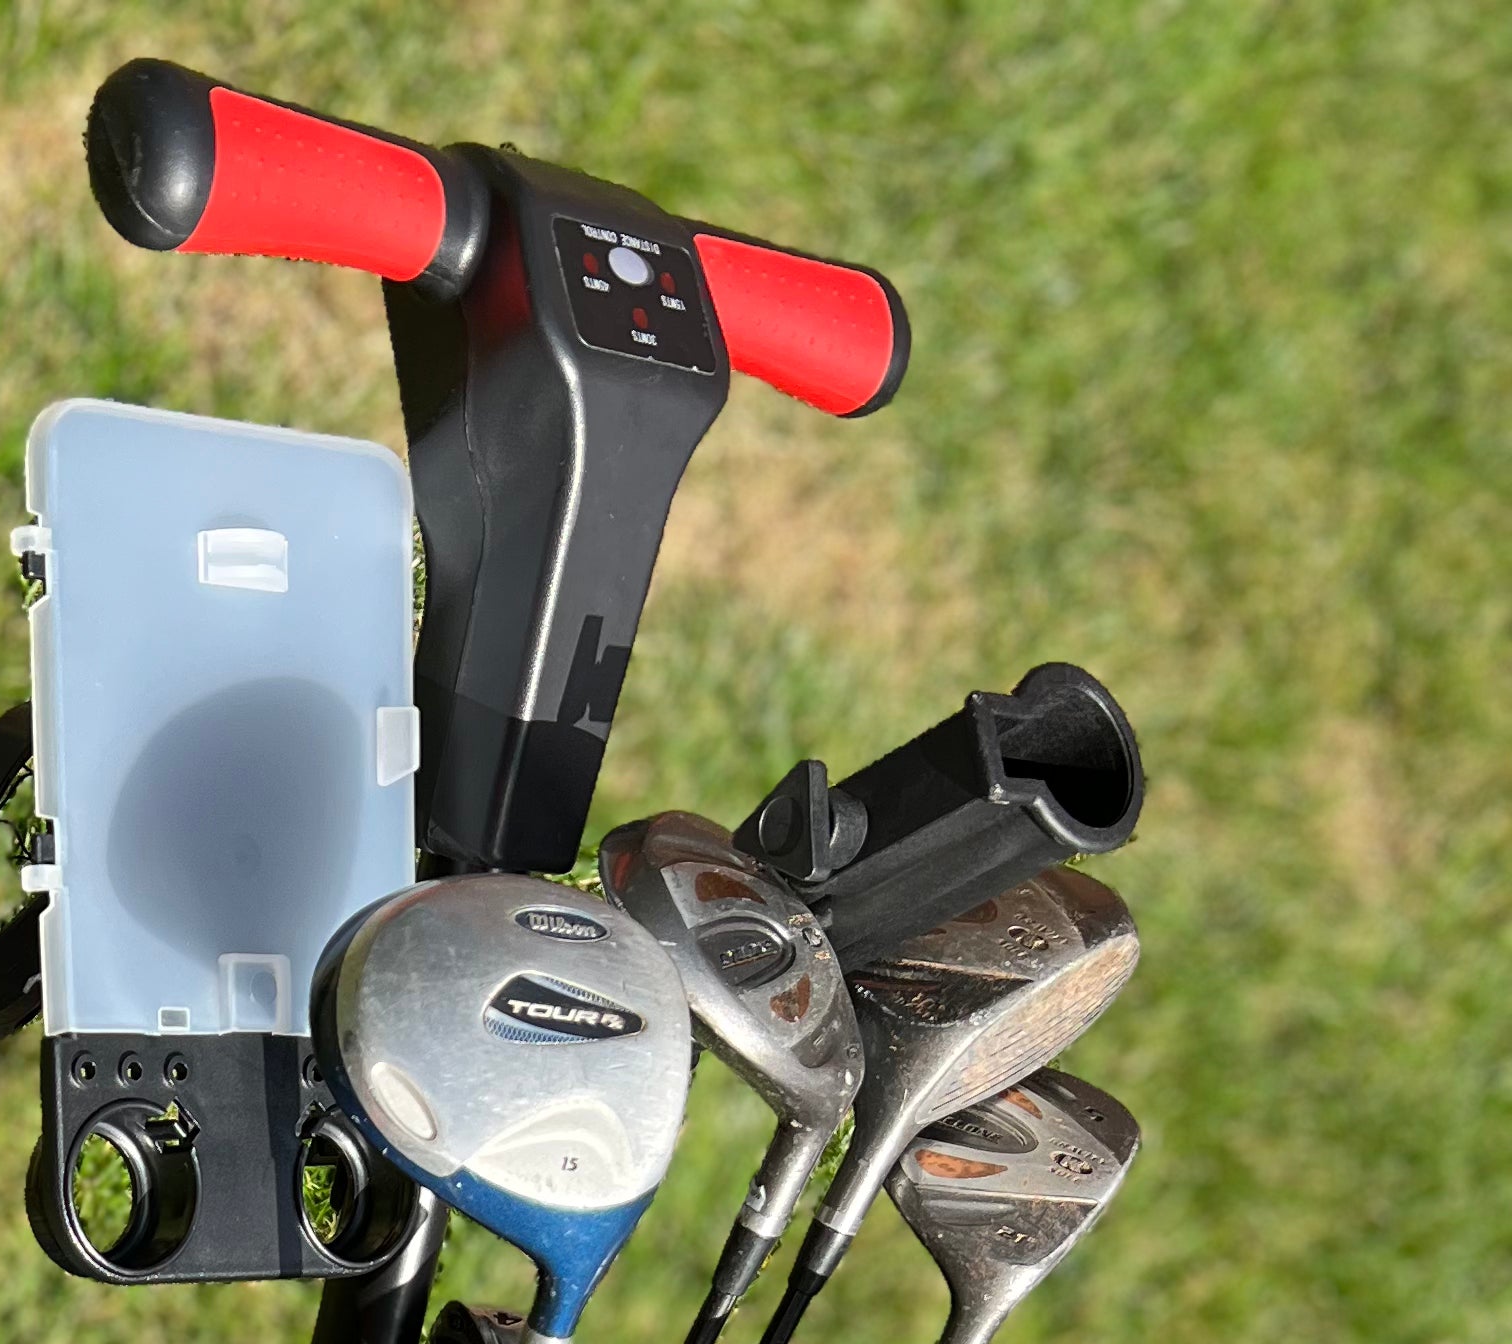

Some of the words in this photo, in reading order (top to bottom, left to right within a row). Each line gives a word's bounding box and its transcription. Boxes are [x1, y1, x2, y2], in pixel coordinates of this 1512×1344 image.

[581, 224, 618, 243] CONTROL
[620, 233, 661, 255] DISTANCE
[527, 912, 597, 938] Wilson
[507, 999, 600, 1026] TOUR
[561, 1156, 579, 1171] 15
